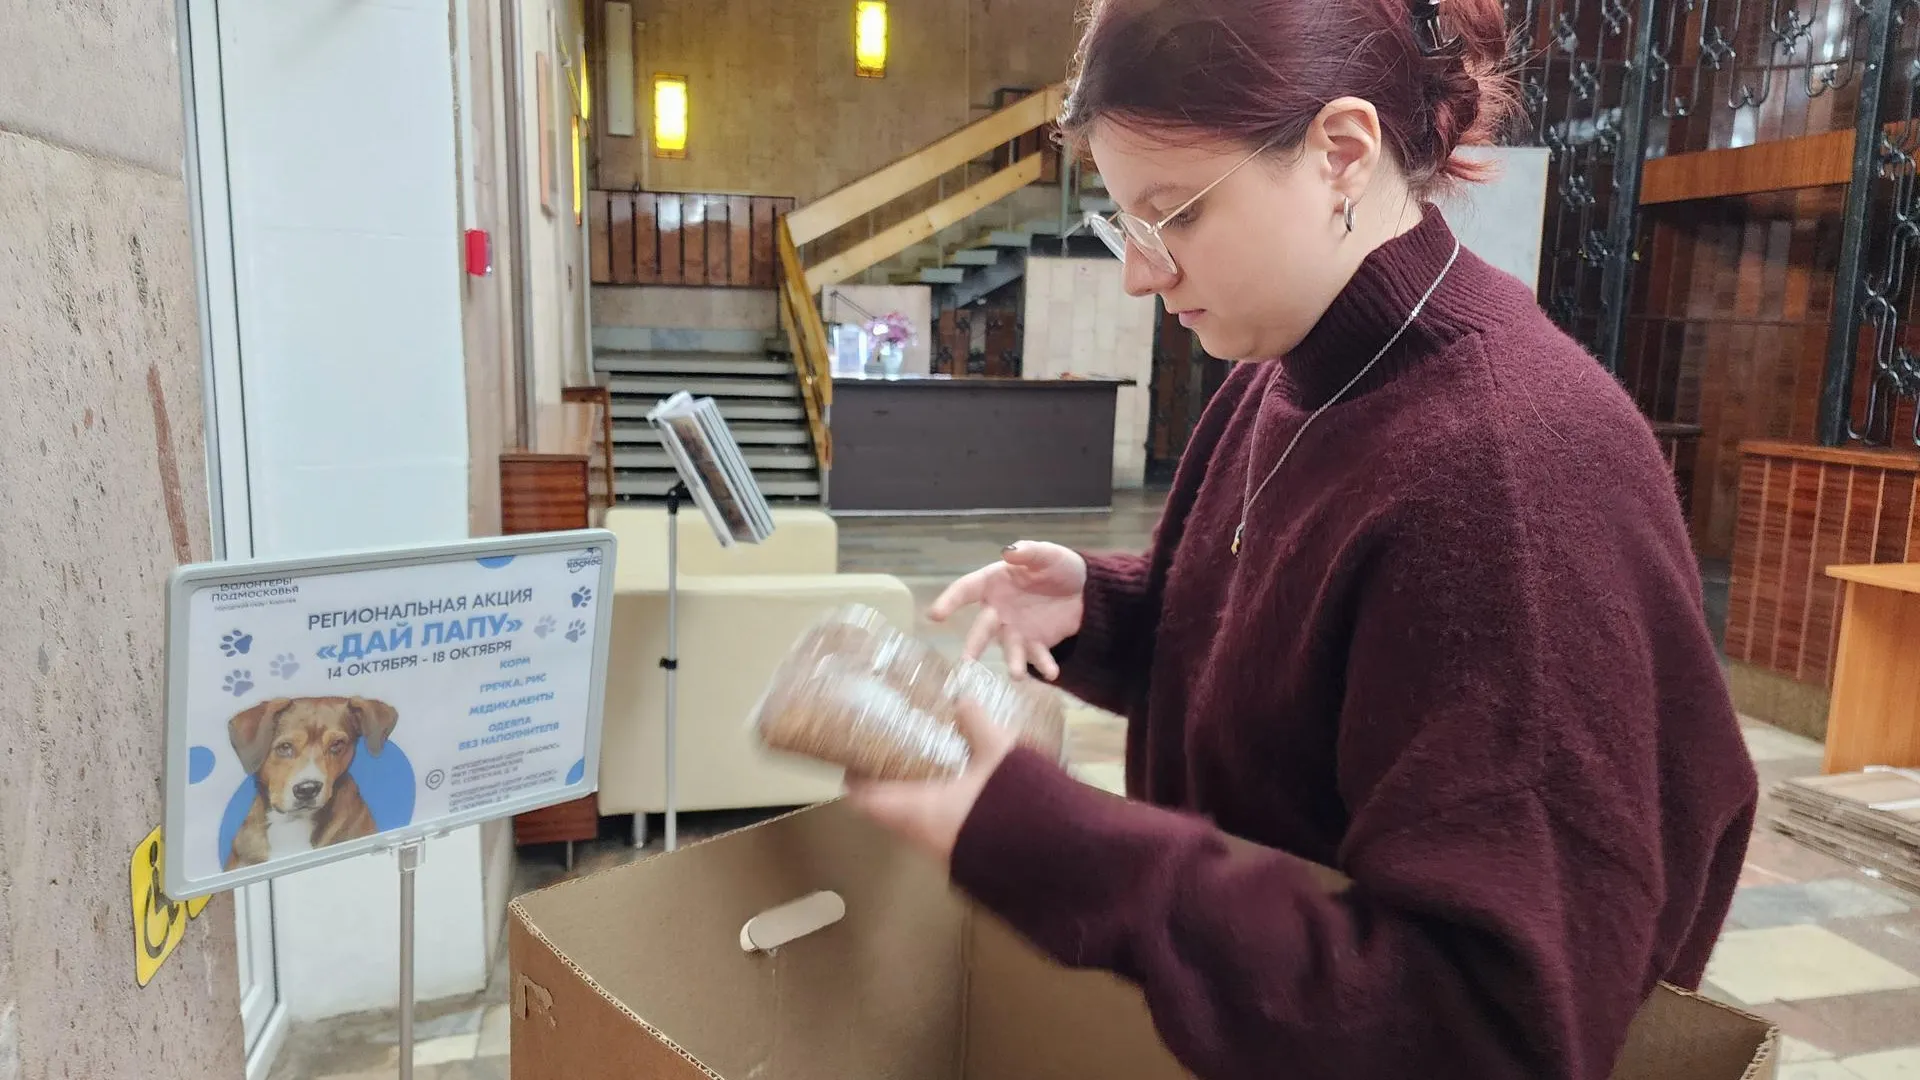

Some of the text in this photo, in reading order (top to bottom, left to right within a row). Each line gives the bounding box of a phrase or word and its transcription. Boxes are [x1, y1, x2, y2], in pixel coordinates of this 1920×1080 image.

[211, 585, 299, 602] ПОДМОСКОВЬЯ
[308, 587, 533, 630] РЕГИОНАЛЬНАЯ АКЦИЯ
[316, 612, 524, 663] «ДАЙ ЛАПУ»
[327, 667, 342, 680] 14
[347, 654, 418, 677] ОКТЯБРЯ
[432, 651, 445, 663] 18
[450, 640, 513, 661] ОКТЯБРЯ
[500, 657, 531, 668] КОРМ
[525, 673, 547, 685] РИС
[469, 692, 555, 716] МЕДИКАМЕНТЫ
[458, 722, 560, 751] БЕЗ НАПОЛНИТЕЛЯ
[488, 716, 532, 733] ОДЕЯЛА
